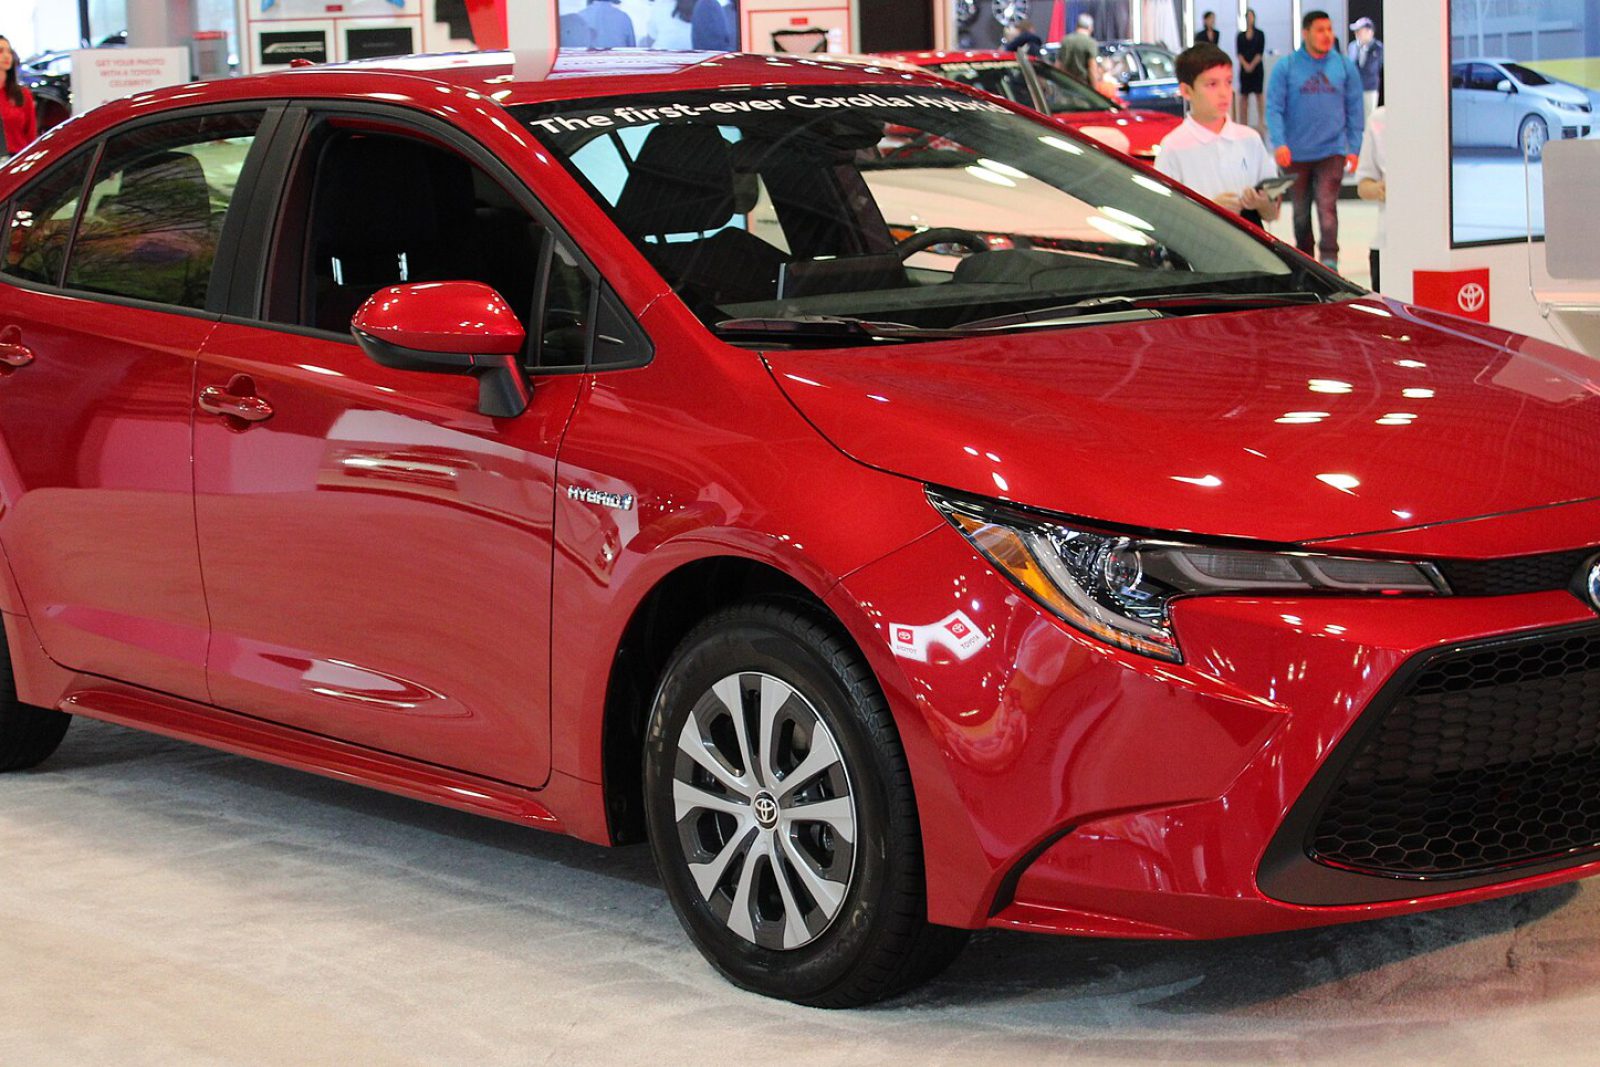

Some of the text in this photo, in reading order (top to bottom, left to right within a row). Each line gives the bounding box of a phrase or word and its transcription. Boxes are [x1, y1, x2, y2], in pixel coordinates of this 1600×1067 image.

[530, 93, 1015, 134] The first-ever Corolla Hybrid
[567, 484, 621, 508] HYBRID
